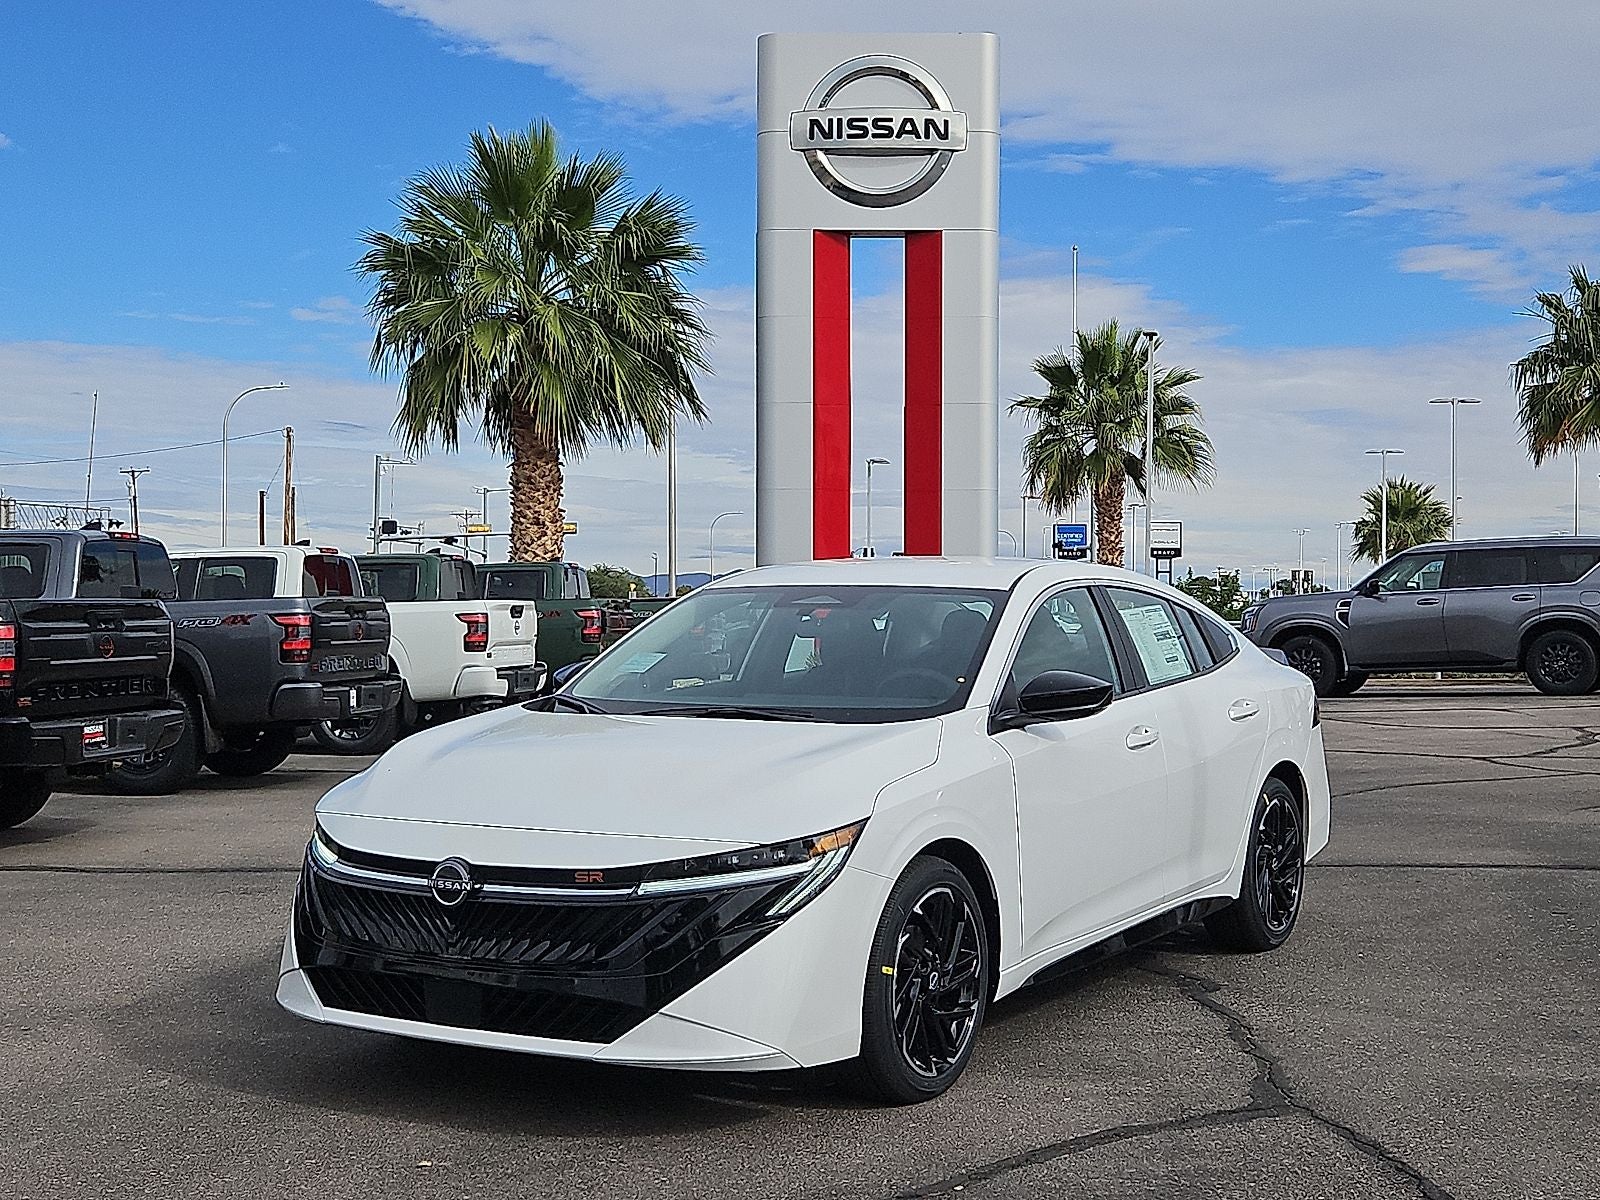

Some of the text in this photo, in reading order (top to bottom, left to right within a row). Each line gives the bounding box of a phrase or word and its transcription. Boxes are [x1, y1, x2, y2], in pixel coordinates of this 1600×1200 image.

[808, 117, 949, 141] NISSAN
[319, 653, 387, 673] FRONTIER
[38, 678, 155, 700] FRONTIER
[428, 879, 472, 891] NISSAN
[574, 871, 605, 883] SR
